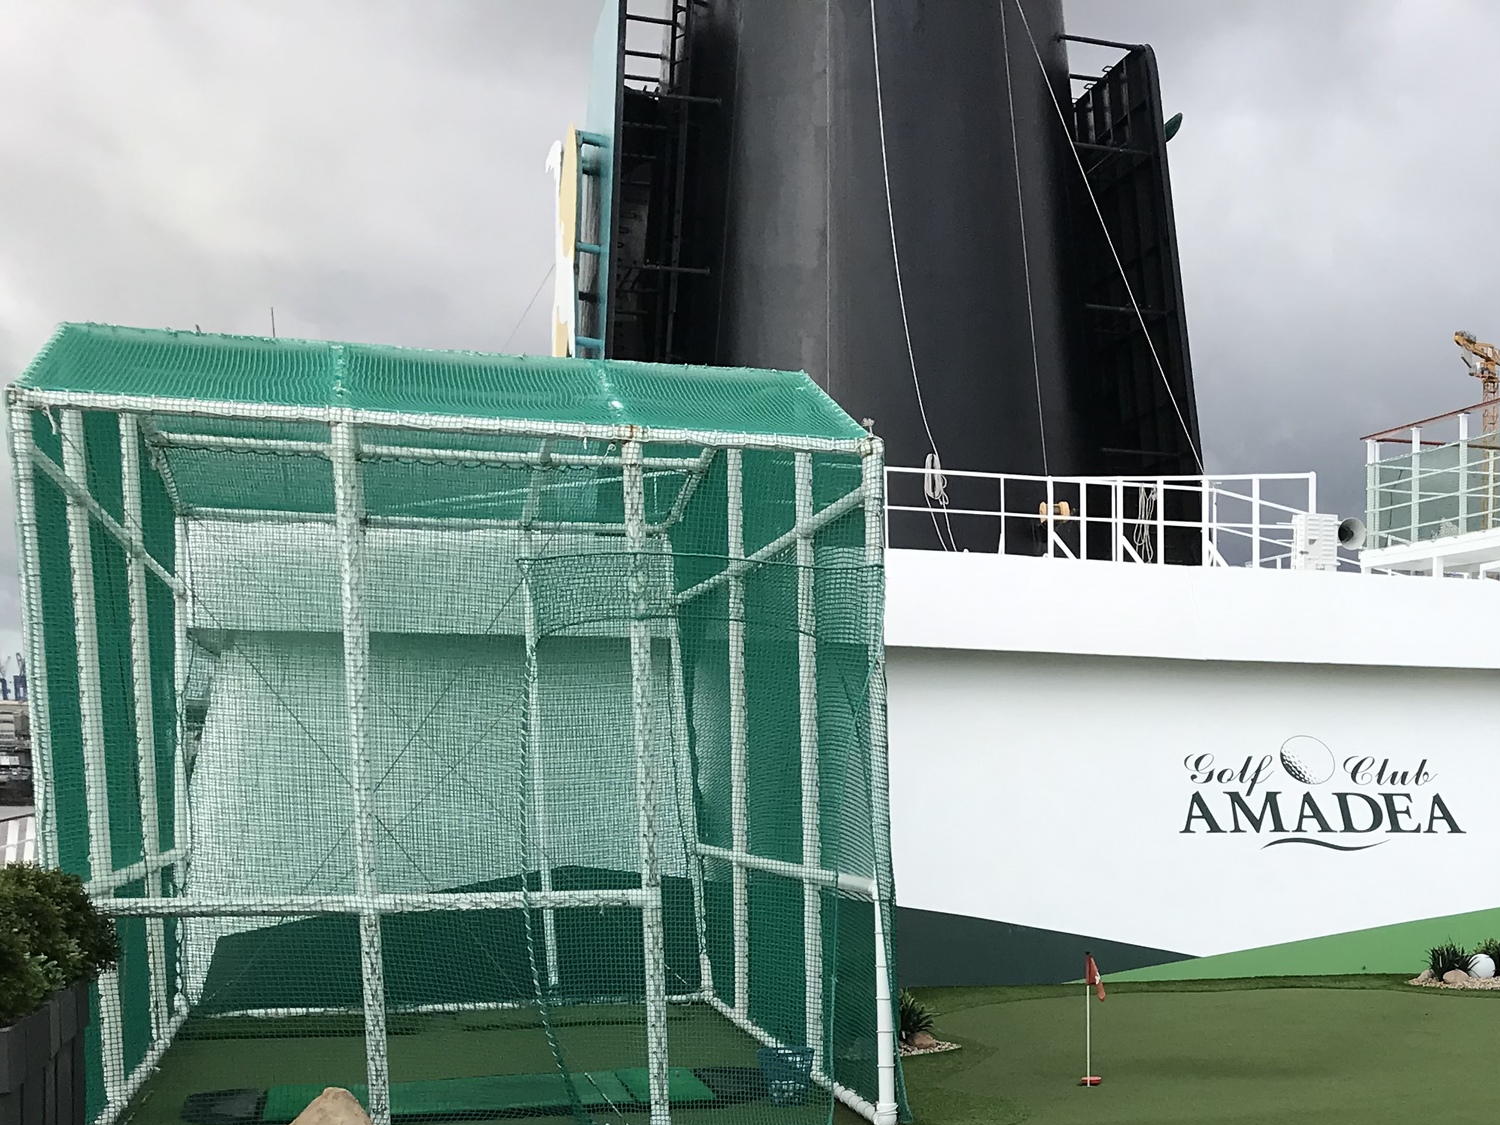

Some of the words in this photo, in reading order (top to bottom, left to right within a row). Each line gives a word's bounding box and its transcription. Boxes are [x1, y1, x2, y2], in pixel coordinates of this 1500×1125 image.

[1183, 752, 1275, 797] Golf
[1342, 755, 1439, 787] Club
[1178, 790, 1467, 834] AMADEA
